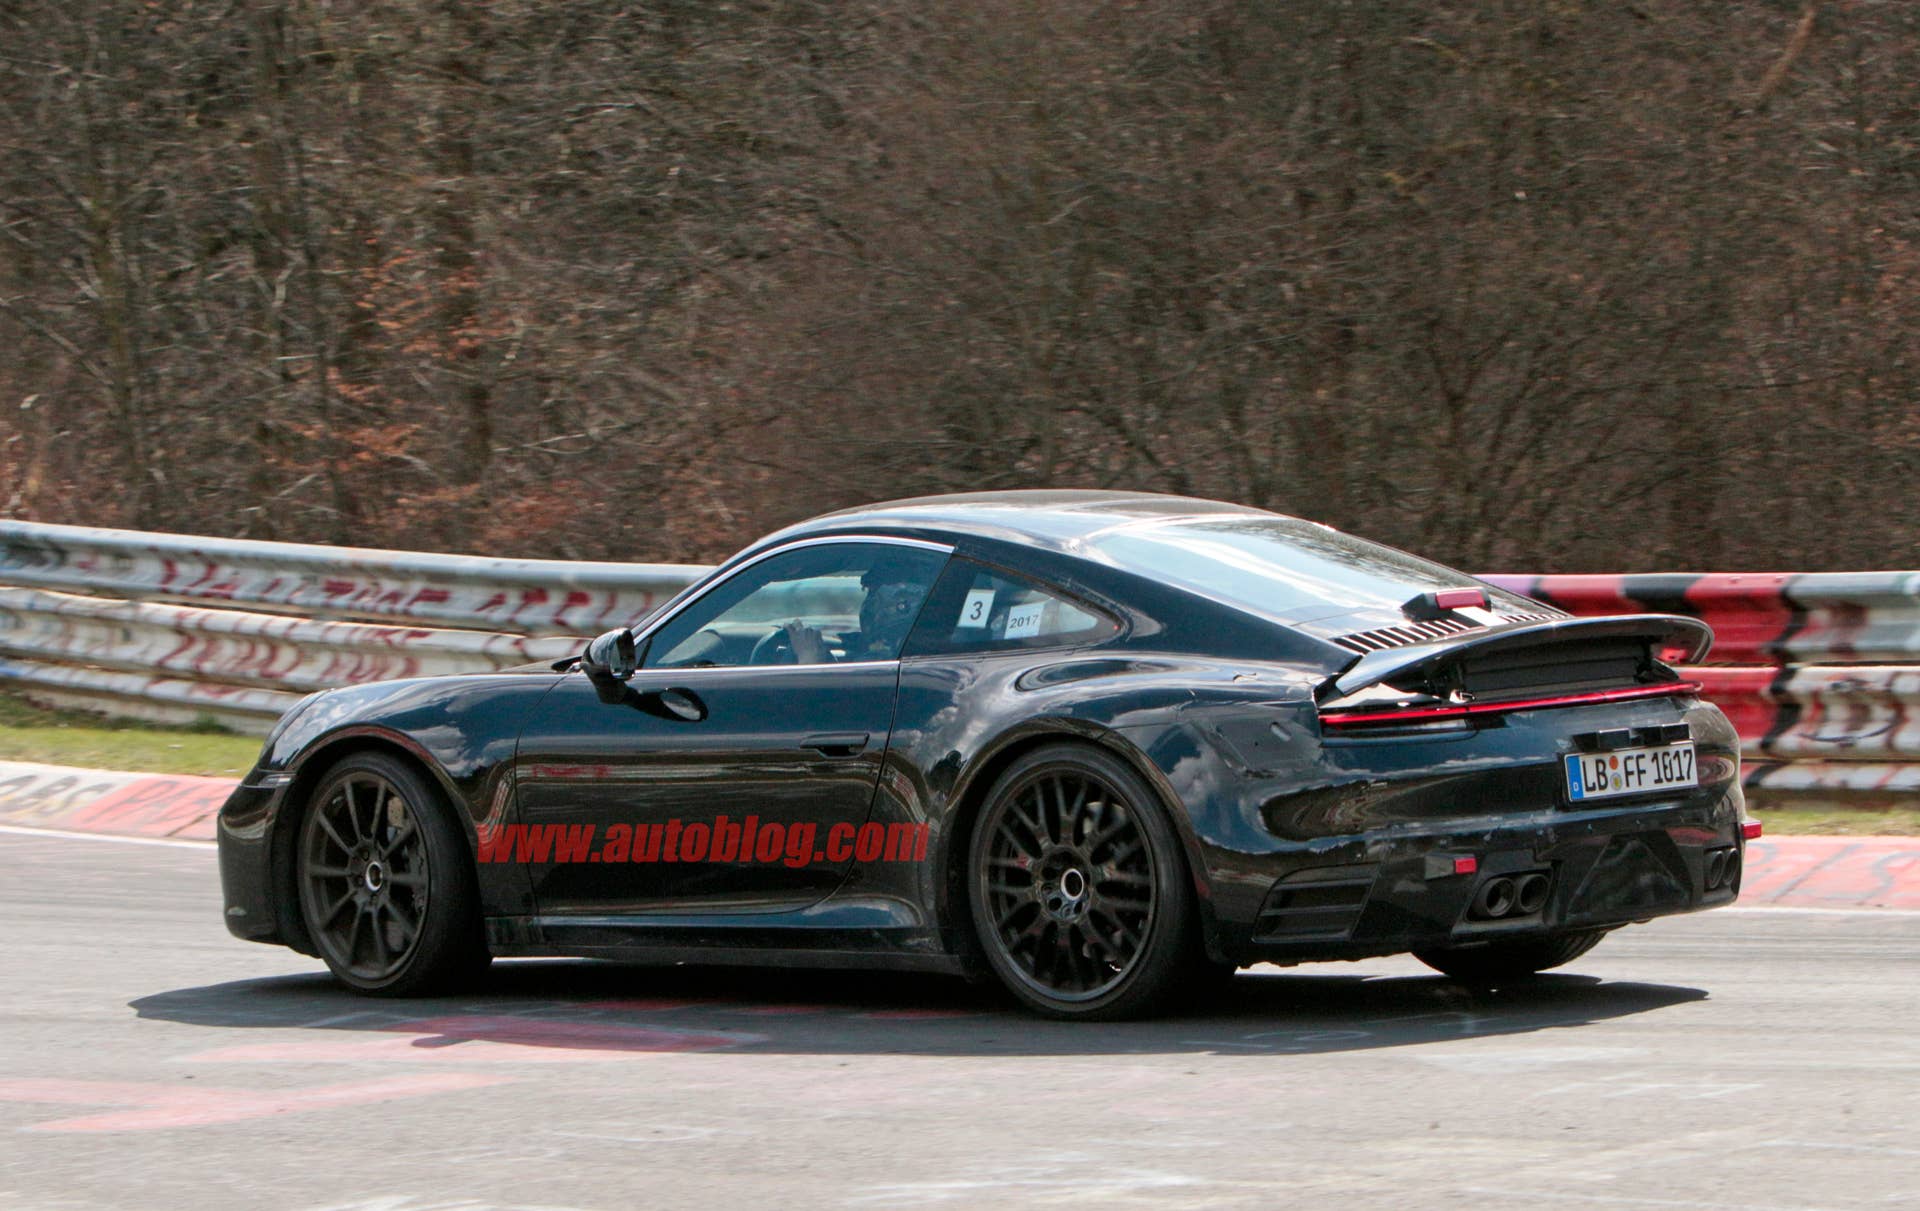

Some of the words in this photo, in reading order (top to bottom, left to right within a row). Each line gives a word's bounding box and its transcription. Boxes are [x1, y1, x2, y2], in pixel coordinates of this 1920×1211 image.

[970, 601, 982, 621] 3
[1009, 614, 1039, 629] 2017
[1582, 759, 1608, 792] LB
[1624, 754, 1646, 787] FF
